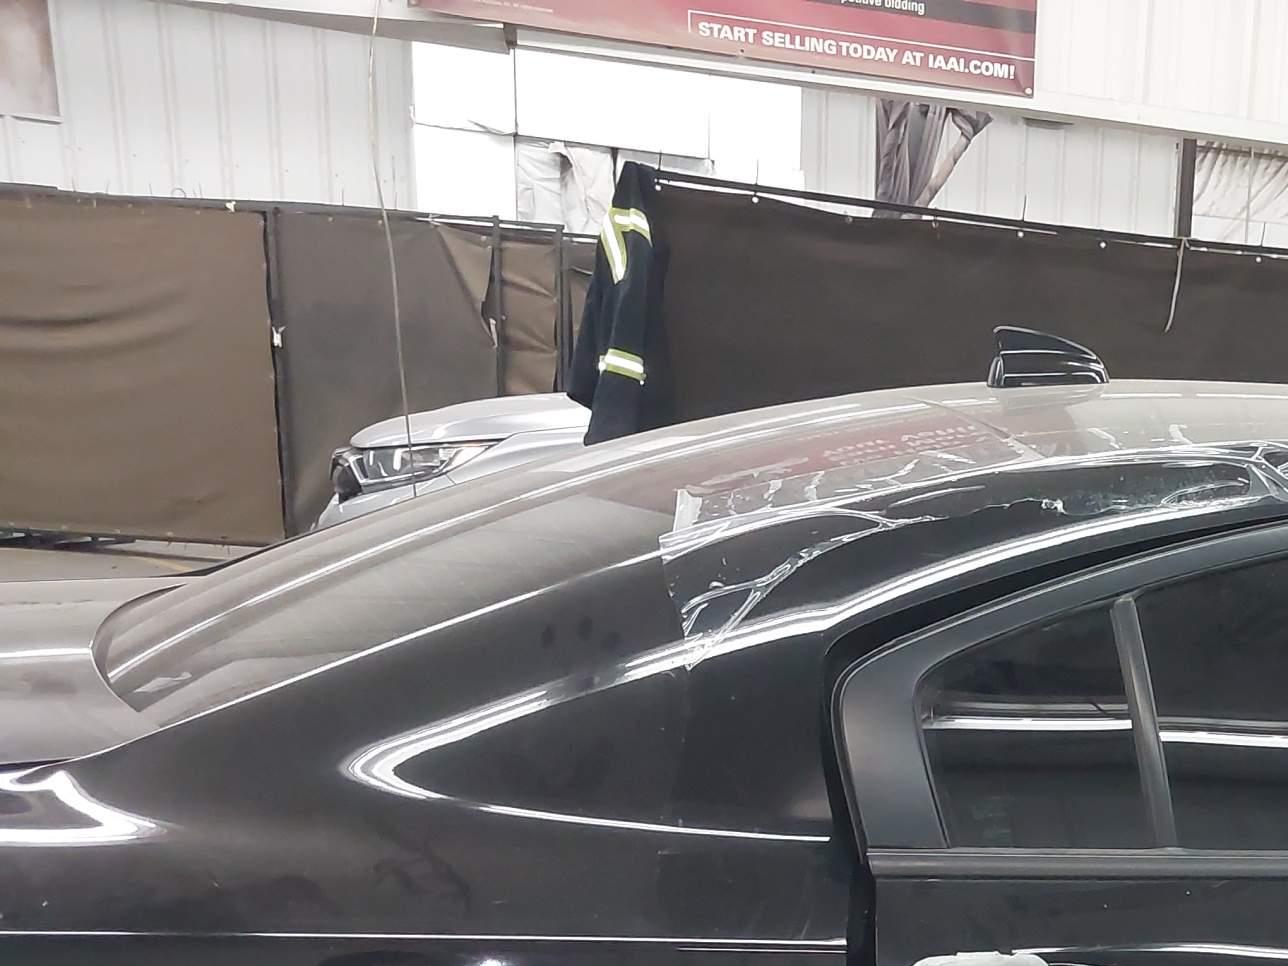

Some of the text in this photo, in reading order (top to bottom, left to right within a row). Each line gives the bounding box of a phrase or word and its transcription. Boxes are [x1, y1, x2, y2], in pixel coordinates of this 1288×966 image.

[698, 22, 1015, 79] START SELLING TODAY AT IAAI.COM!
